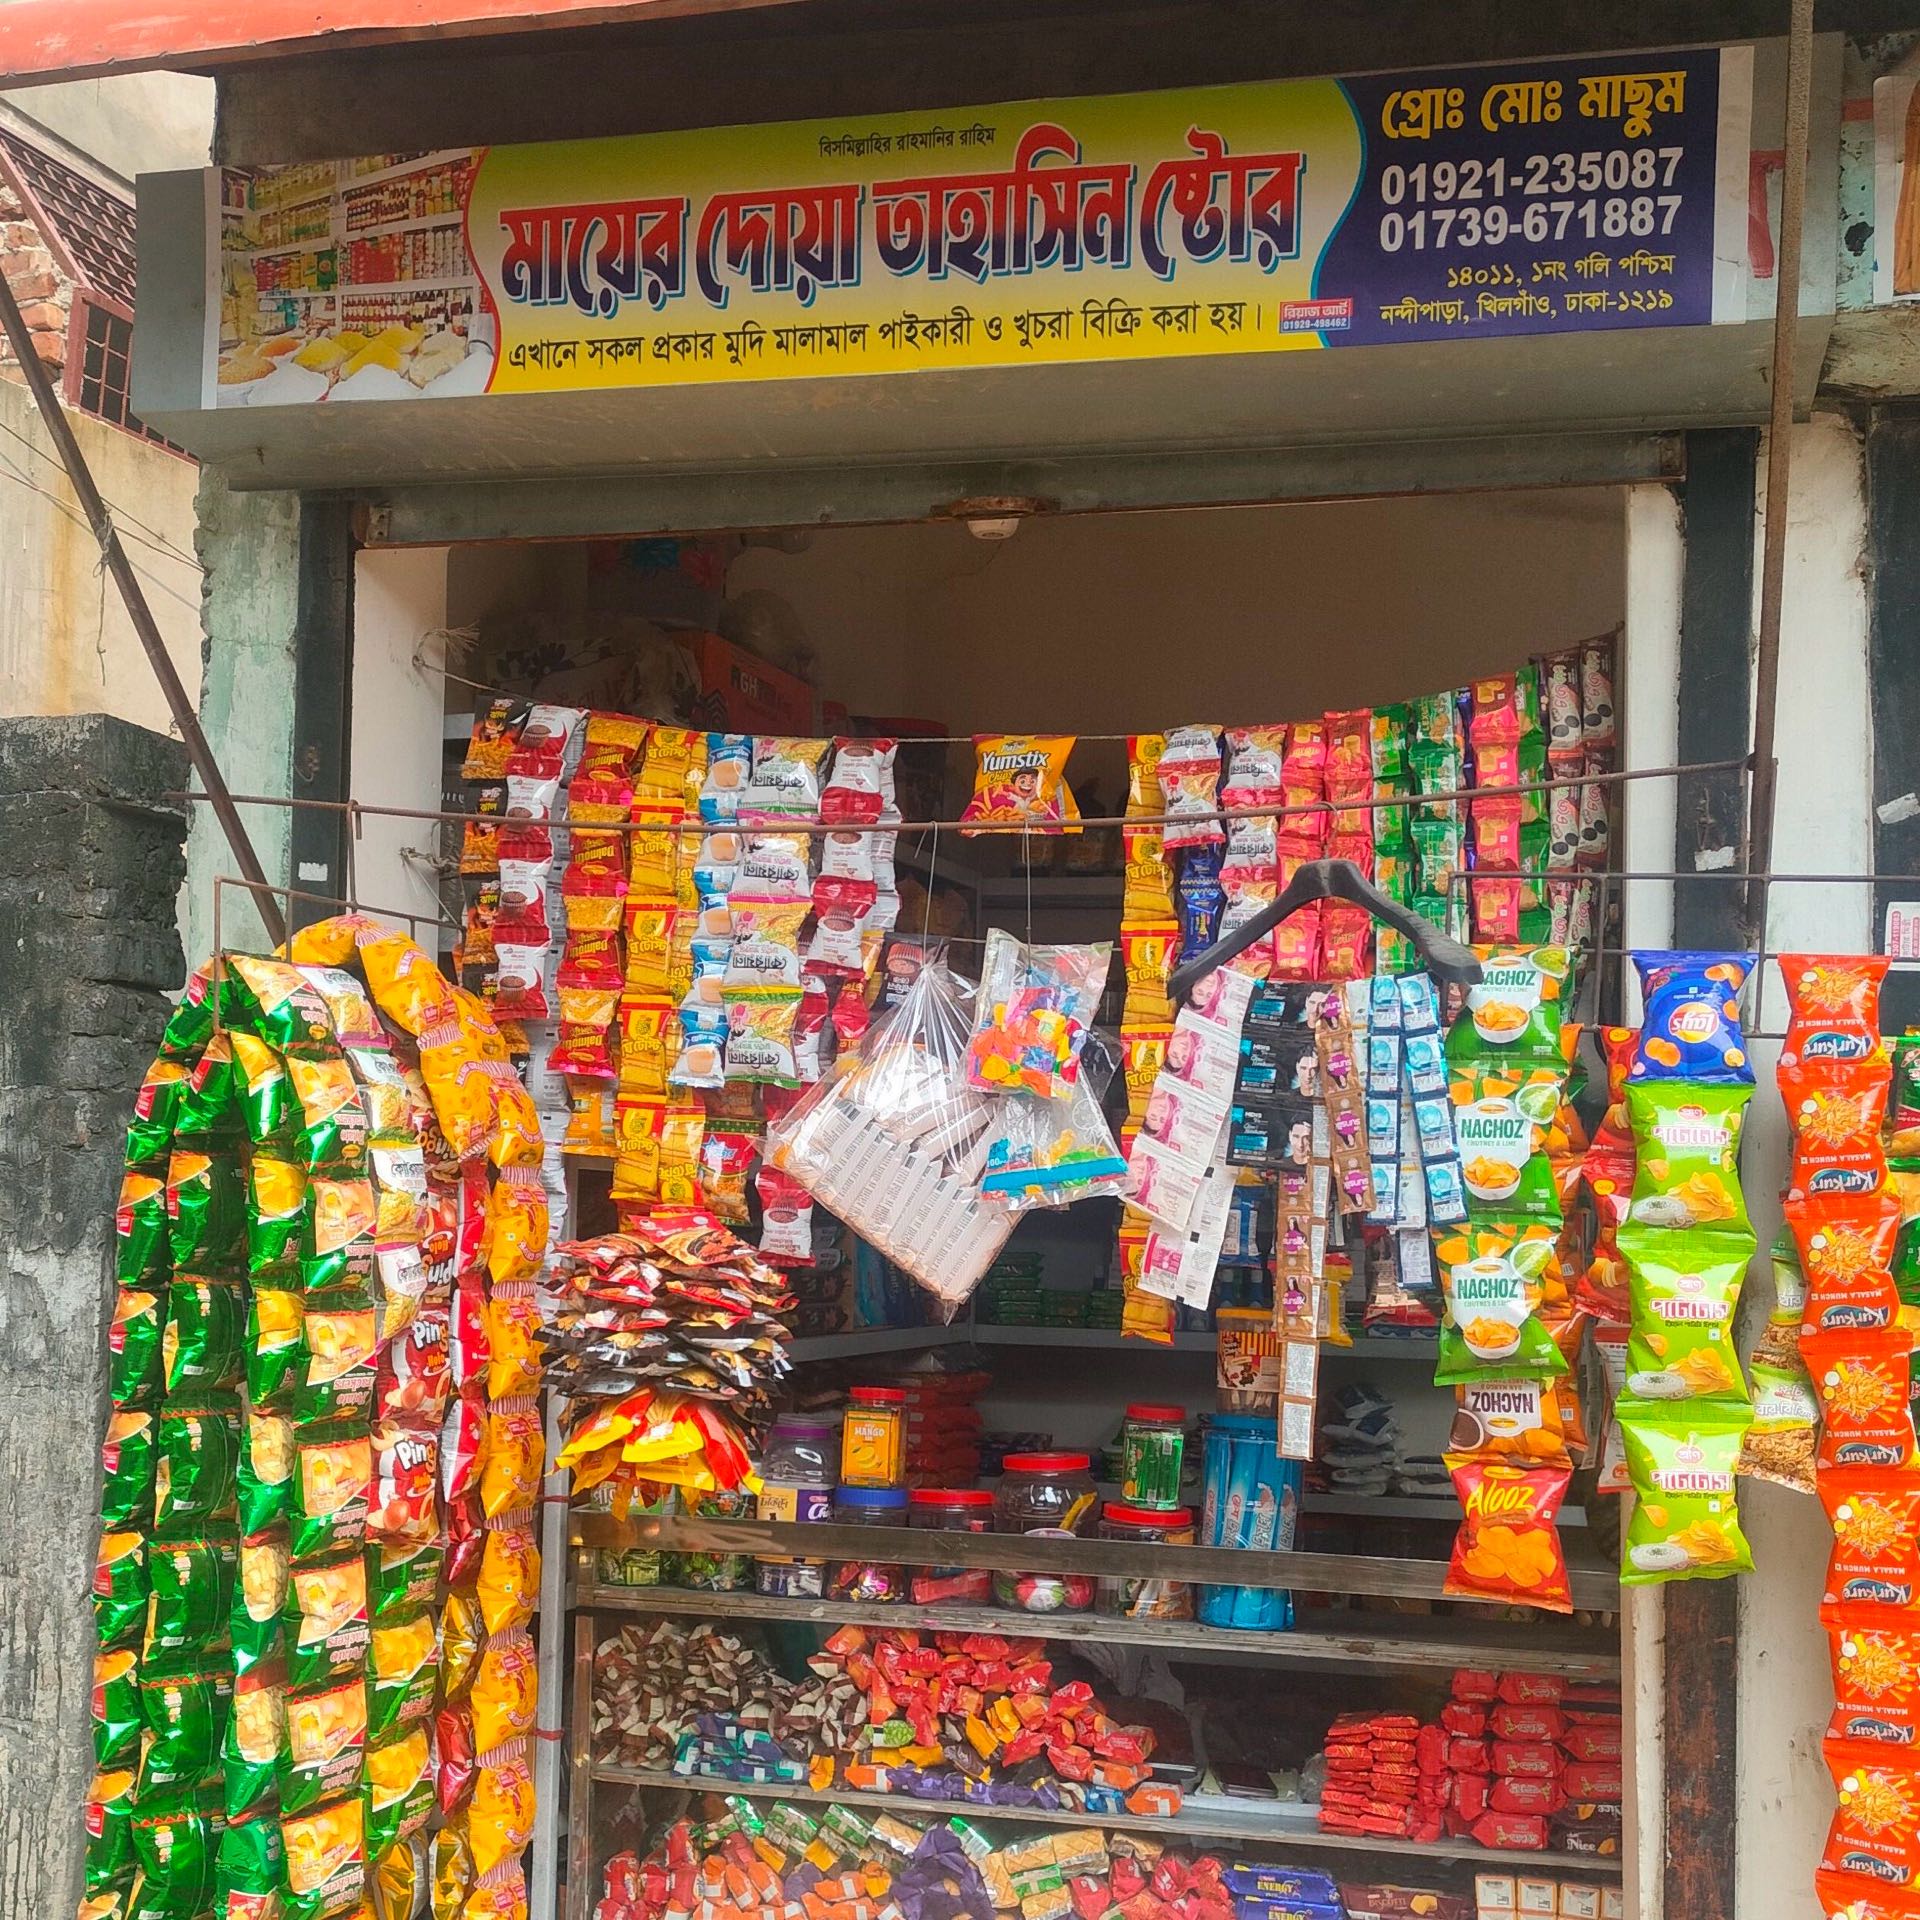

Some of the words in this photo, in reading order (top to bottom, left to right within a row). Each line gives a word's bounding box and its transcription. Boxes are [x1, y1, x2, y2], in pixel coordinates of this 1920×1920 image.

[1381, 87, 1465, 139] প্রোঃ
[1480, 80, 1563, 132] মোঃ
[1578, 70, 1687, 139] মাছুম
[959, 125, 996, 147] রাহিম
[1381, 147, 1684, 206] 01921-235087
[1379, 195, 1683, 253] 01739-671887
[499, 196, 689, 319] মায়ের
[696, 182, 866, 309] দোয়া
[1573, 251, 1611, 279] গলি
[1618, 249, 1676, 276] পশ্চিম
[1564, 288, 1674, 313] ঢাকা-১২১৯
[508, 337, 577, 371] এখানে
[587, 336, 644, 368] সকল
[652, 331, 716, 363] প্রকার
[724, 321, 764, 366] মুদি
[772, 322, 869, 358] মালামাল
[878, 304, 975, 350] পাইকারী
[983, 321, 1003, 342] ও
[1013, 308, 1073, 347] খুচরা
[1080, 297, 1142, 340] বিক্রি
[1151, 302, 1198, 336] করা
[1208, 300, 1247, 336] হয়
[982, 750, 1052, 775] Yumstix
[1483, 969, 1538, 987] ACHOZ
[1803, 1032, 1872, 1058] Kurkure
[1460, 1118, 1525, 1138] NACHOZ
[1810, 1168, 1879, 1193] Kurkure
[1457, 1278, 1520, 1300] NACHOZ
[1821, 1304, 1890, 1328] Kurkure
[1471, 1391, 1534, 1413] NACHOZ
[854, 1426, 885, 1437] MANGO
[1836, 1443, 1903, 1466] Kurkure
[1843, 1578, 1909, 1604] Kurkure
[1847, 1716, 1914, 1743] Kurkure
[1567, 1838, 1597, 1851] Nice
[1841, 1852, 1909, 1883] Kurkure
[1257, 1880, 1294, 1894] ENERGY
